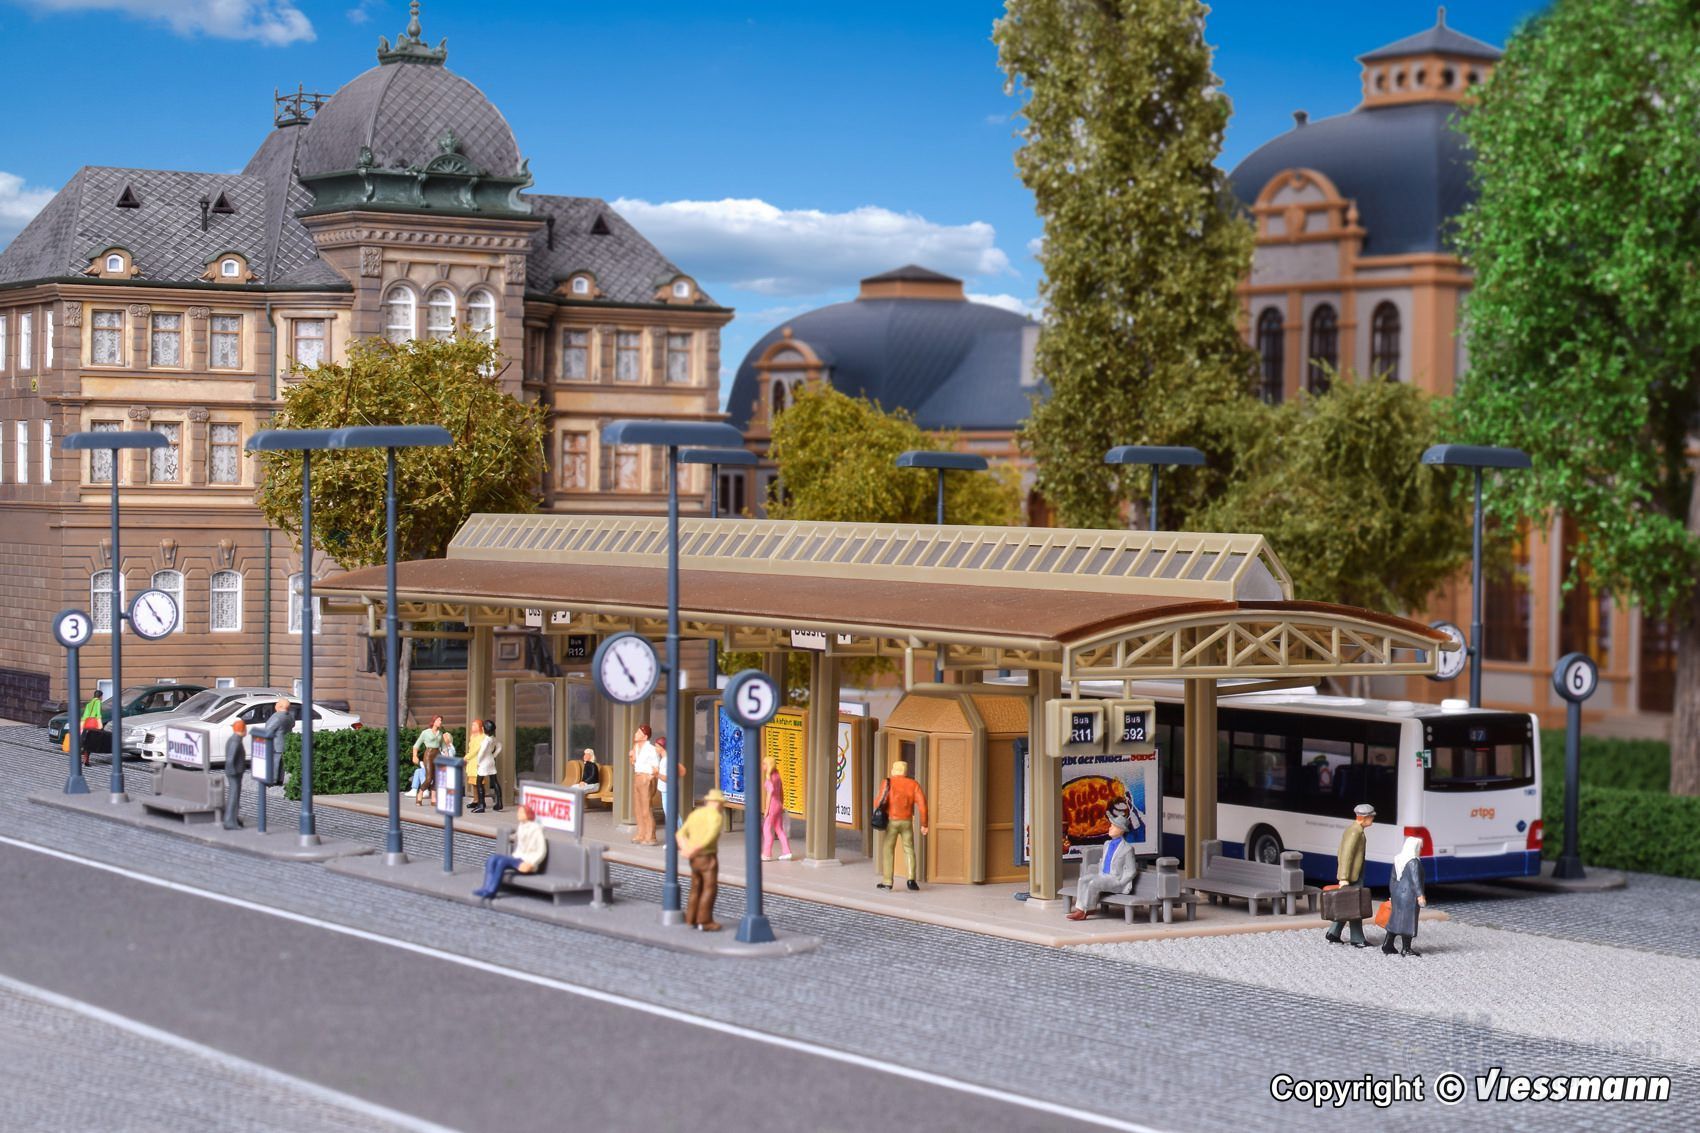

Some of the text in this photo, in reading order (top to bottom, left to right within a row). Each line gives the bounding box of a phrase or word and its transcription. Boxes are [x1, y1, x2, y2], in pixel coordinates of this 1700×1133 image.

[69, 618, 79, 639] 3
[568, 647, 584, 656] R12
[1573, 665, 1584, 690] 6
[748, 685, 761, 714] 5
[1073, 715, 1089, 725] Bus
[1125, 714, 1141, 724] Bus
[1070, 728, 1091, 742] R11
[1123, 727, 1144, 741] 592
[168, 740, 195, 757] PUMA
[525, 793, 571, 821] VOLLMER
